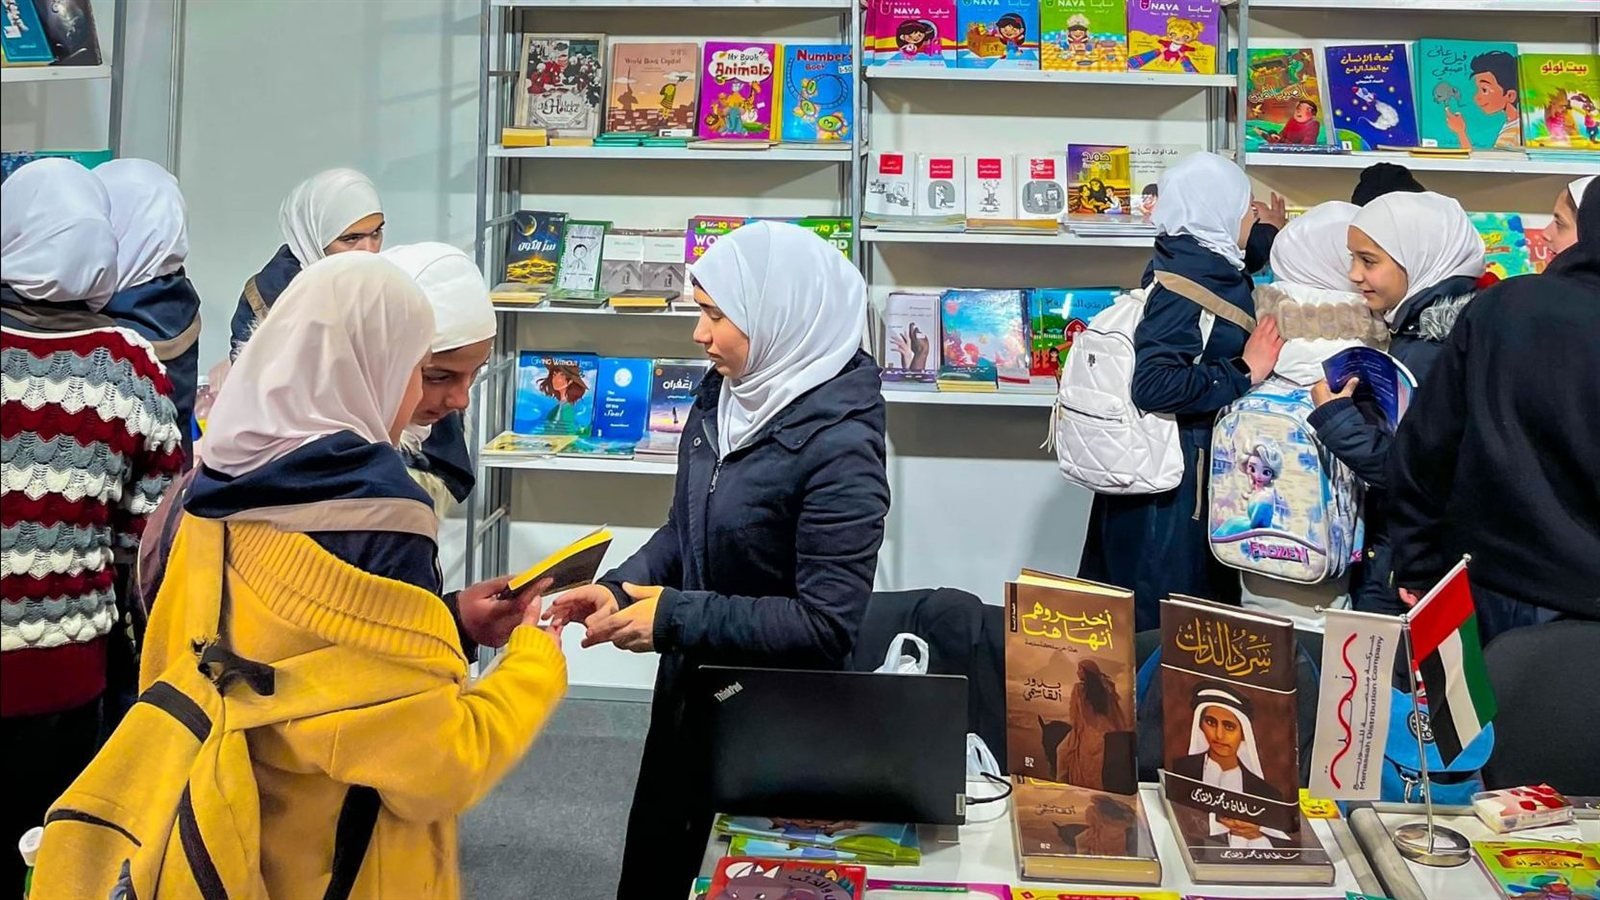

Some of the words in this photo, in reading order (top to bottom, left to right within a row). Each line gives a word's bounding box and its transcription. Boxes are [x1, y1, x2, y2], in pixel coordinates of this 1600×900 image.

[1150, 3, 1180, 11] NAYA
[740, 53, 759, 61] Book
[796, 49, 852, 62] Numbers
[715, 62, 771, 77] Animals
[1565, 62, 1588, 76] بيت
[1250, 541, 1310, 566] FROZEN
[1021, 601, 1113, 630] أخبروهم
[1021, 617, 1062, 639] هنا
[1062, 618, 1113, 651] أنها
[1371, 636, 1385, 681] Company
[713, 681, 743, 702] ThinkPad
[1022, 677, 1062, 691] بدور
[1366, 683, 1378, 741] Distribution
